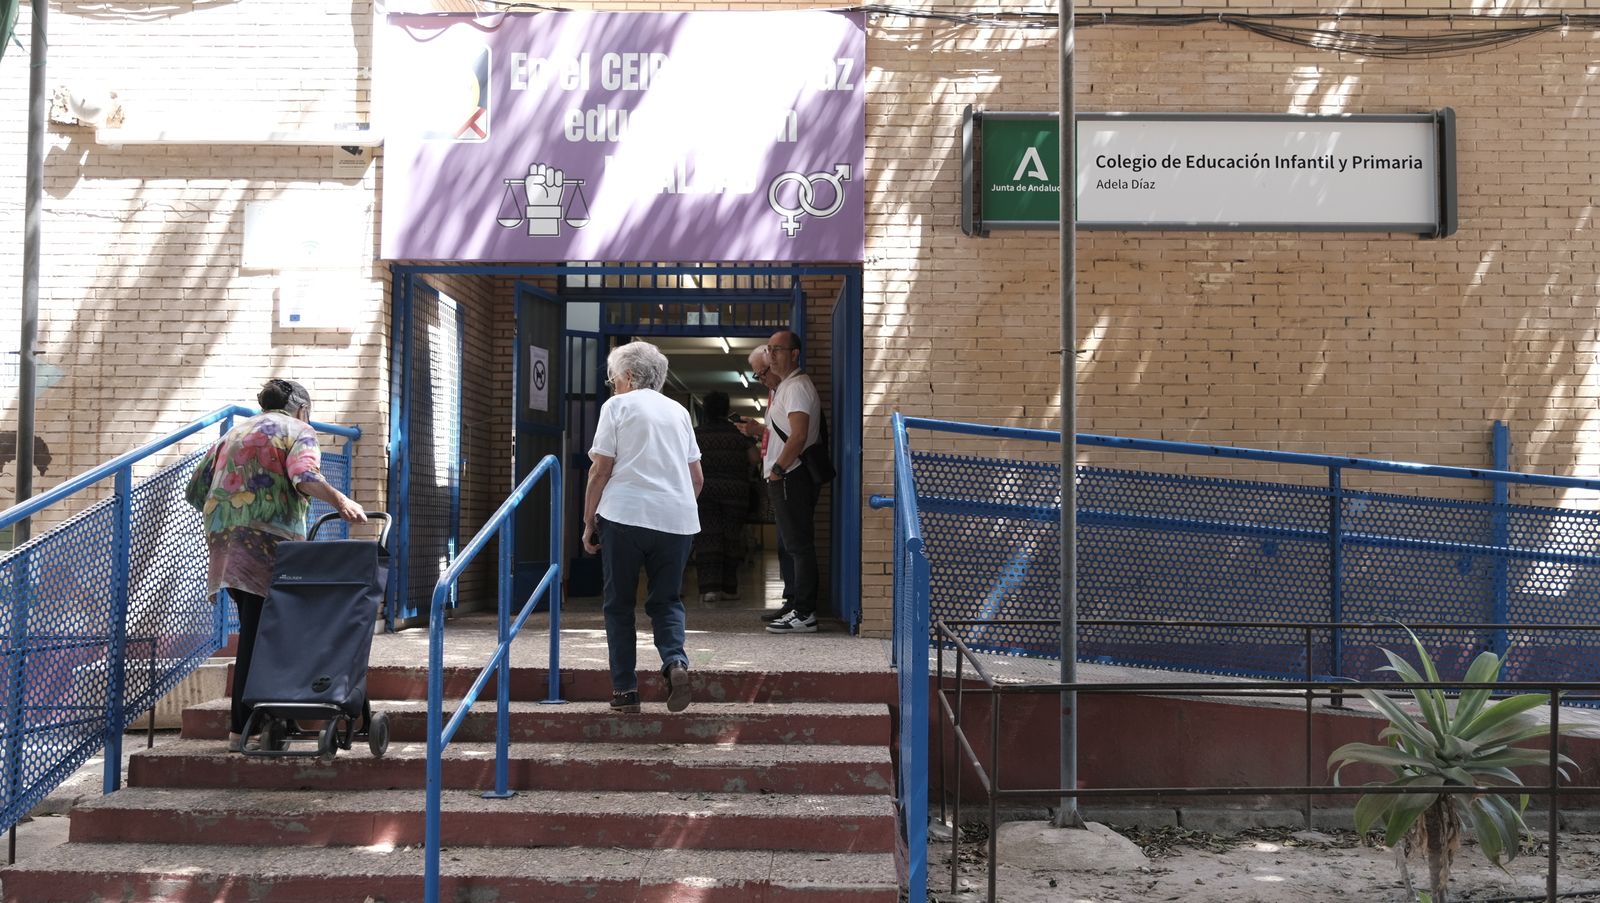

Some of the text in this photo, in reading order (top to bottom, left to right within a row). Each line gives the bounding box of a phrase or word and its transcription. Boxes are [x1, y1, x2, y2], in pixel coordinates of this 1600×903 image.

[511, 52, 550, 90] En
[559, 52, 590, 90] el
[1095, 153, 1423, 172] Colegio de Educación Infantil y Primaria
[991, 184, 1061, 192] Junta de Andaluc
[1096, 178, 1156, 190] Adela Díaz
